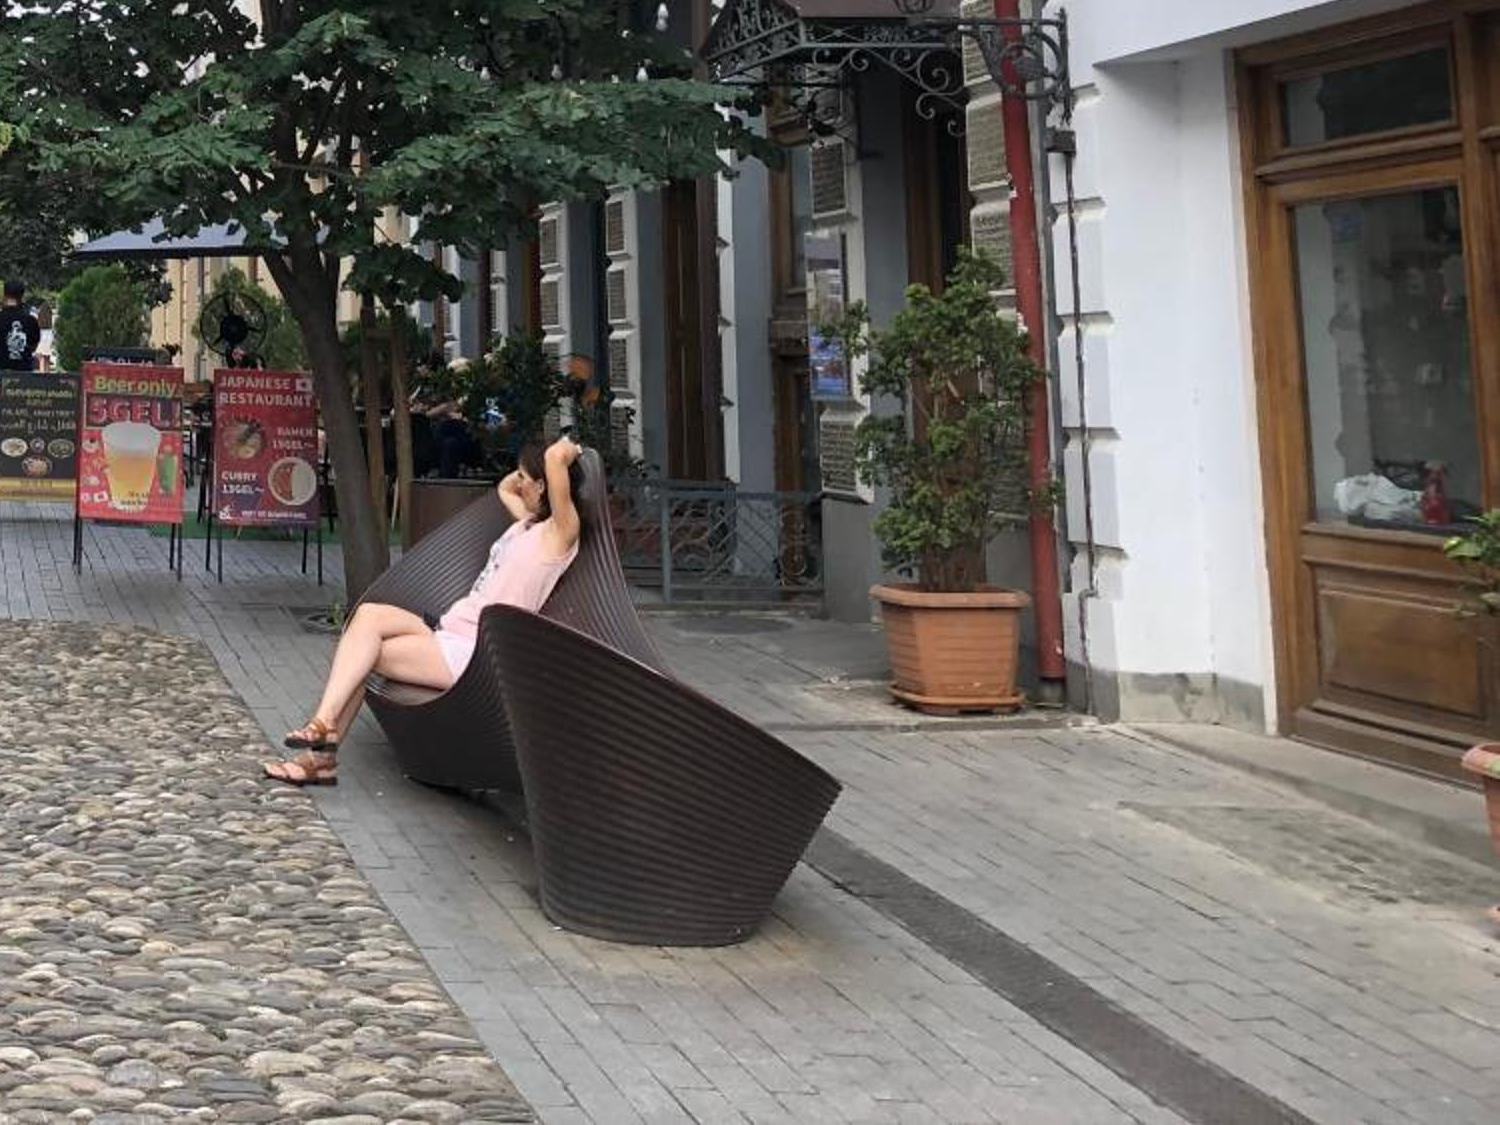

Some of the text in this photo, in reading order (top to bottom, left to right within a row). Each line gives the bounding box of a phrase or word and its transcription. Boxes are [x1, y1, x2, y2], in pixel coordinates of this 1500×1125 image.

[94, 376, 134, 394] Beer
[137, 378, 177, 398] only
[219, 377, 291, 390] JAPANESE
[219, 392, 313, 407] RESTAURANT
[221, 470, 257, 482] CURRY
